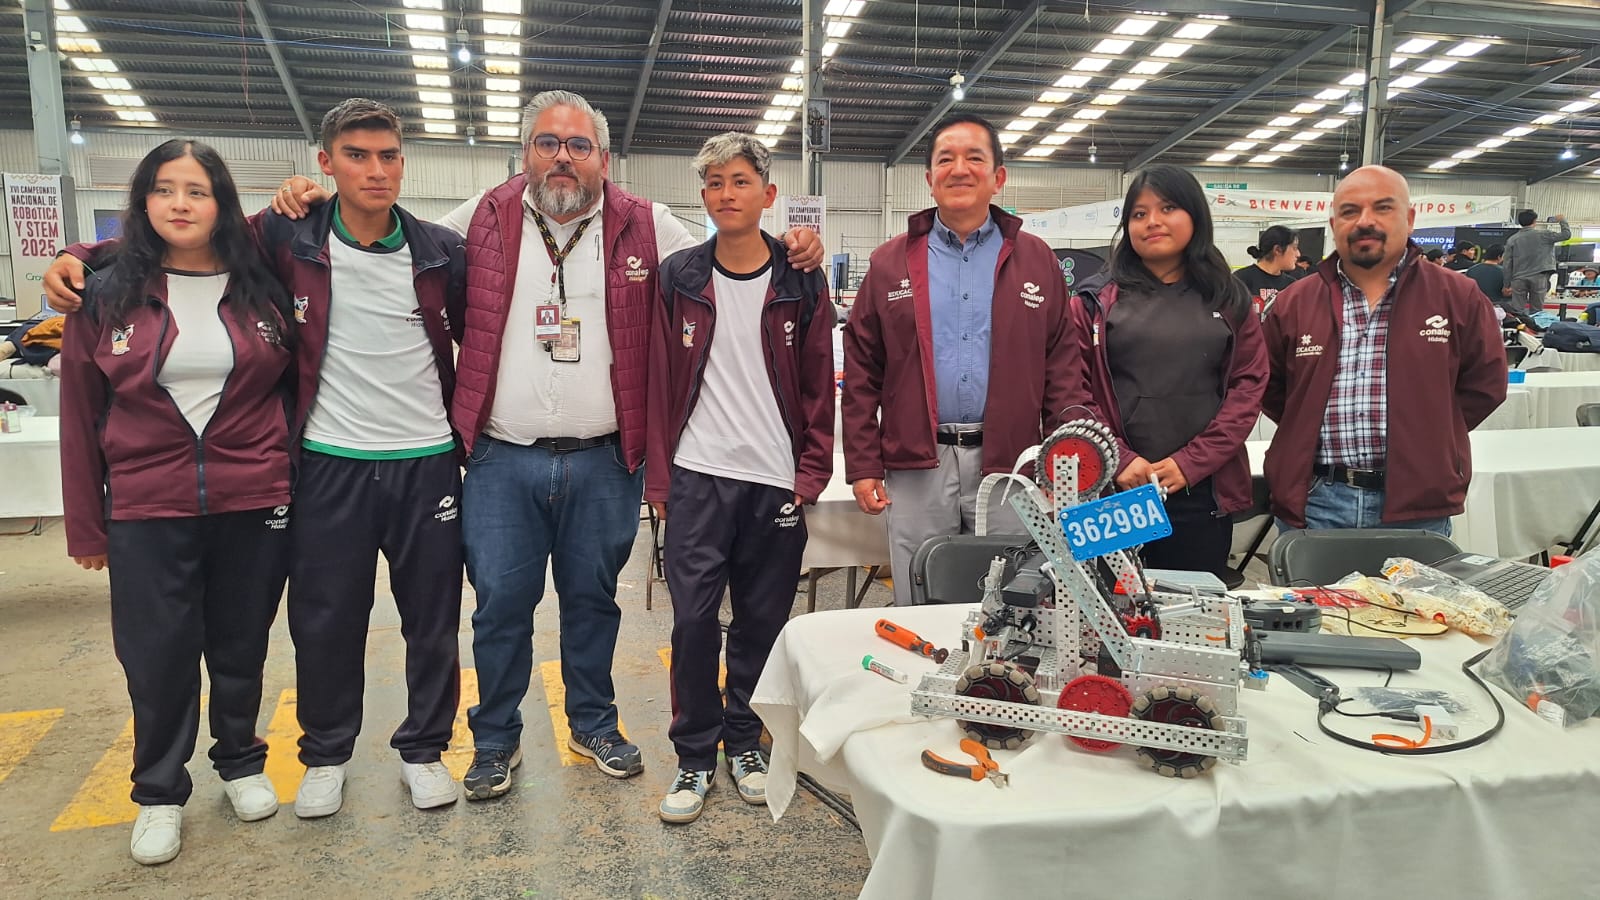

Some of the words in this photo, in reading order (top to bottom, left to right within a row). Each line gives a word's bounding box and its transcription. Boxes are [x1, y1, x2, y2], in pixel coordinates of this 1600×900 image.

[20, 185, 57, 195] CAMPEONATO
[11, 195, 47, 206] NACIONAL
[48, 196, 57, 206] DE
[14, 220, 23, 237] Y
[26, 221, 59, 237] STEM
[21, 238, 56, 257] 2025
[1020, 291, 1045, 303] conalep
[1419, 328, 1451, 338] conalep
[1067, 499, 1165, 547] 36298A
